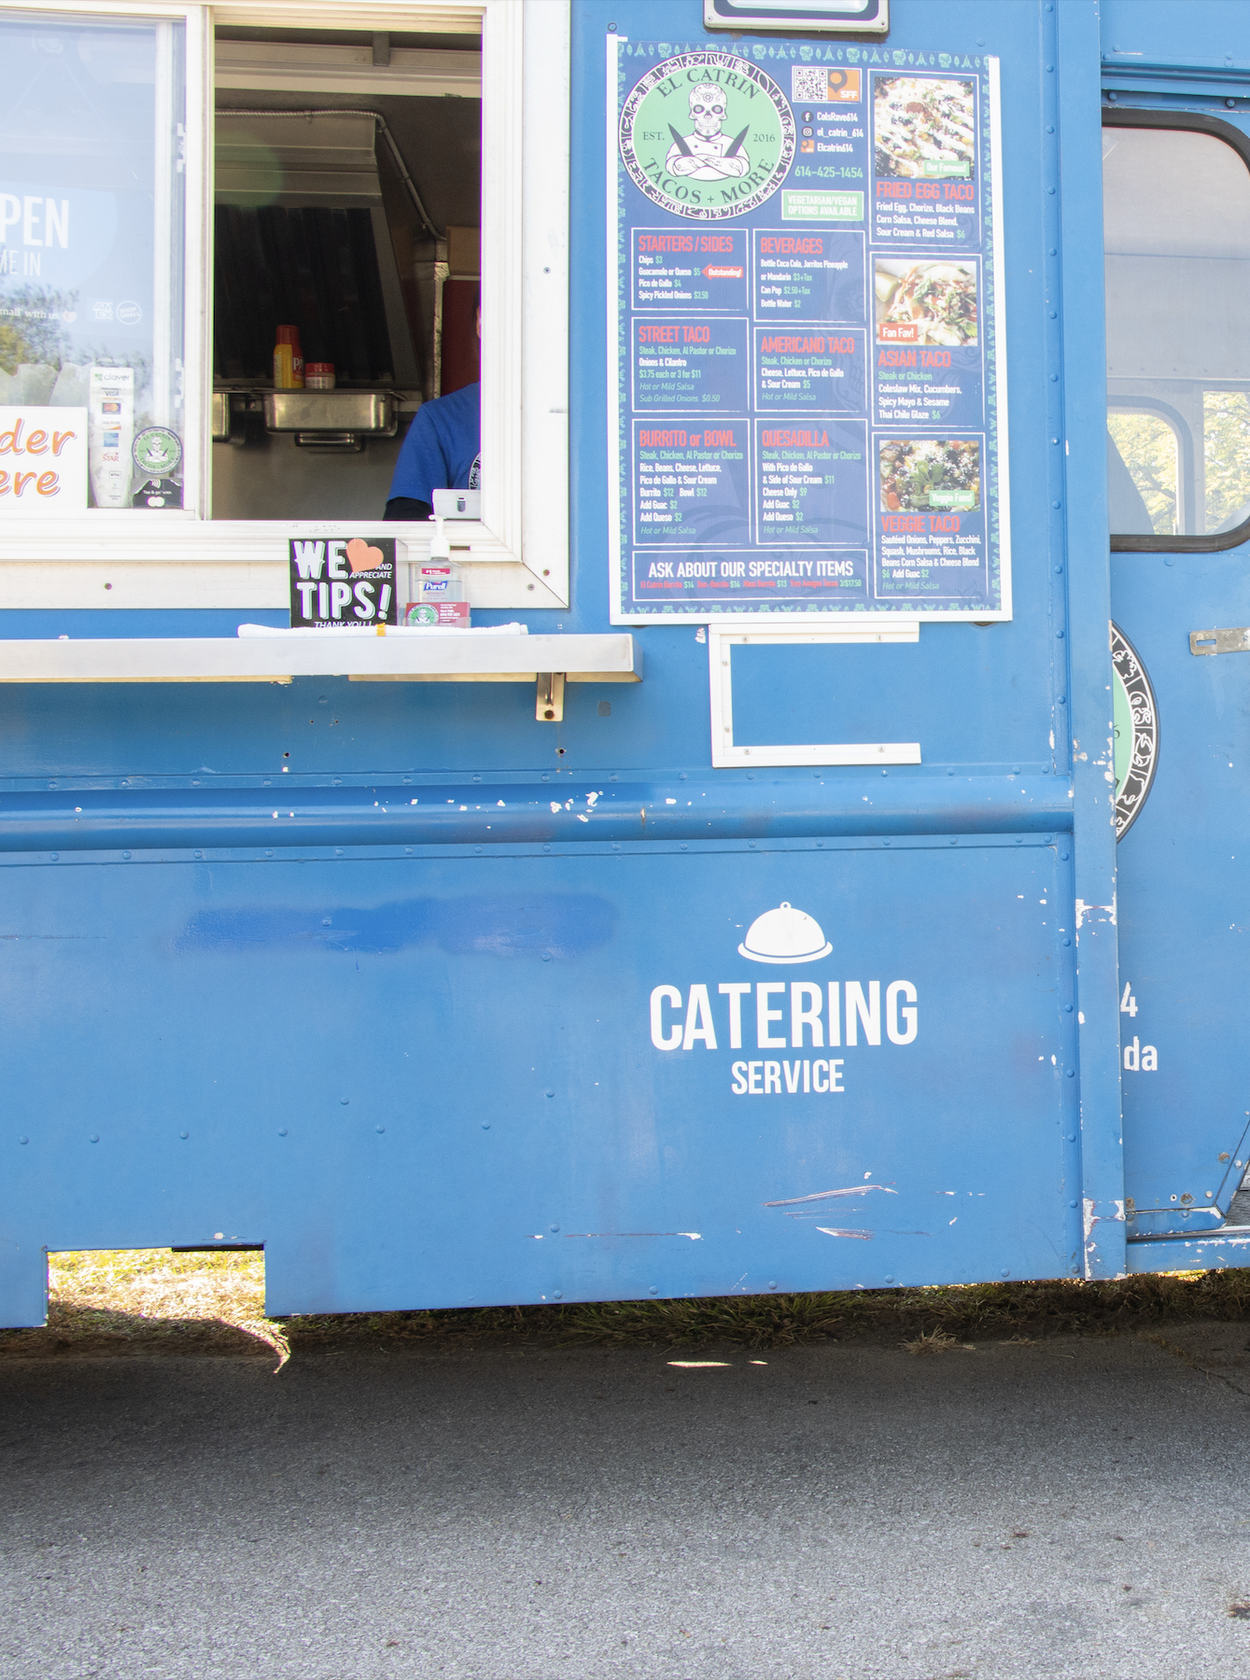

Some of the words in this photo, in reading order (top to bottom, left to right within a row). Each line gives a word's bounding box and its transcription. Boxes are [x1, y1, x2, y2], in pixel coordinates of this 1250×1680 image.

[655, 76, 682, 99] EL
[686, 68, 760, 100] CATRIN
[642, 131, 665, 141] EST.
[752, 133, 776, 143] 2016
[795, 166, 863, 178] 614-425-1454
[643, 158, 701, 204] TACOS
[720, 158, 774, 204] MORE
[877, 182, 911, 198] FRIED
[916, 183, 939, 199] EGG
[943, 184, 974, 200] TACO
[788, 196, 857, 205] VEGETARIAN/VEGAN
[788, 206, 818, 215] OPTIONS
[820, 207, 857, 215] AVAILABLE
[0, 193, 69, 249] PEN
[639, 236, 693, 251] STARTERS
[701, 237, 733, 252] SIDES
[761, 238, 822, 254] BEVERAGES
[24, 252, 41, 277] IN
[24, 309, 46, 319] with
[48, 312, 59, 320] us
[639, 326, 680, 342] STREET
[682, 327, 710, 342] TACO
[883, 328, 896, 337] Fan
[898, 328, 914, 337] Fav!
[761, 337, 824, 353] AMERICANO
[827, 338, 854, 353] TACO
[878, 351, 916, 366] ASIAN
[919, 352, 951, 367] TACO
[879, 372, 897, 380] Steak
[907, 372, 932, 380] Chicken
[0, 418, 76, 456] der
[640, 431, 686, 446] BURRITO
[690, 435, 701, 446] or
[705, 431, 736, 446] BOWL
[763, 431, 829, 446] QUESADILLA
[102, 454, 119, 462] STAR
[0, 470, 59, 497] ere
[640, 488, 661, 496] Burrito
[664, 488, 674, 497] $12
[680, 488, 694, 496] Bowl
[697, 488, 707, 497] $12
[763, 488, 783, 496] Cheese
[785, 488, 797, 498] Only
[800, 488, 807, 496] $9
[640, 500, 651, 509] Add
[653, 500, 667, 509] Guac
[670, 500, 677, 509] $2
[881, 516, 925, 532] VEGGIE
[929, 516, 960, 532] TACO
[293, 540, 347, 579] WE
[349, 571, 392, 579] APPRECIATE
[649, 562, 674, 577] ASK
[677, 562, 717, 577] ABOUT
[721, 562, 745, 577] OUR
[749, 561, 813, 576] SPECIALTY
[817, 561, 853, 576] ITEMS
[296, 581, 391, 620] TIPS!
[1120, 981, 1138, 1017] 4
[650, 980, 918, 1050] CATERING
[1123, 1036, 1158, 1071] da
[731, 1059, 845, 1094] SERVICE
